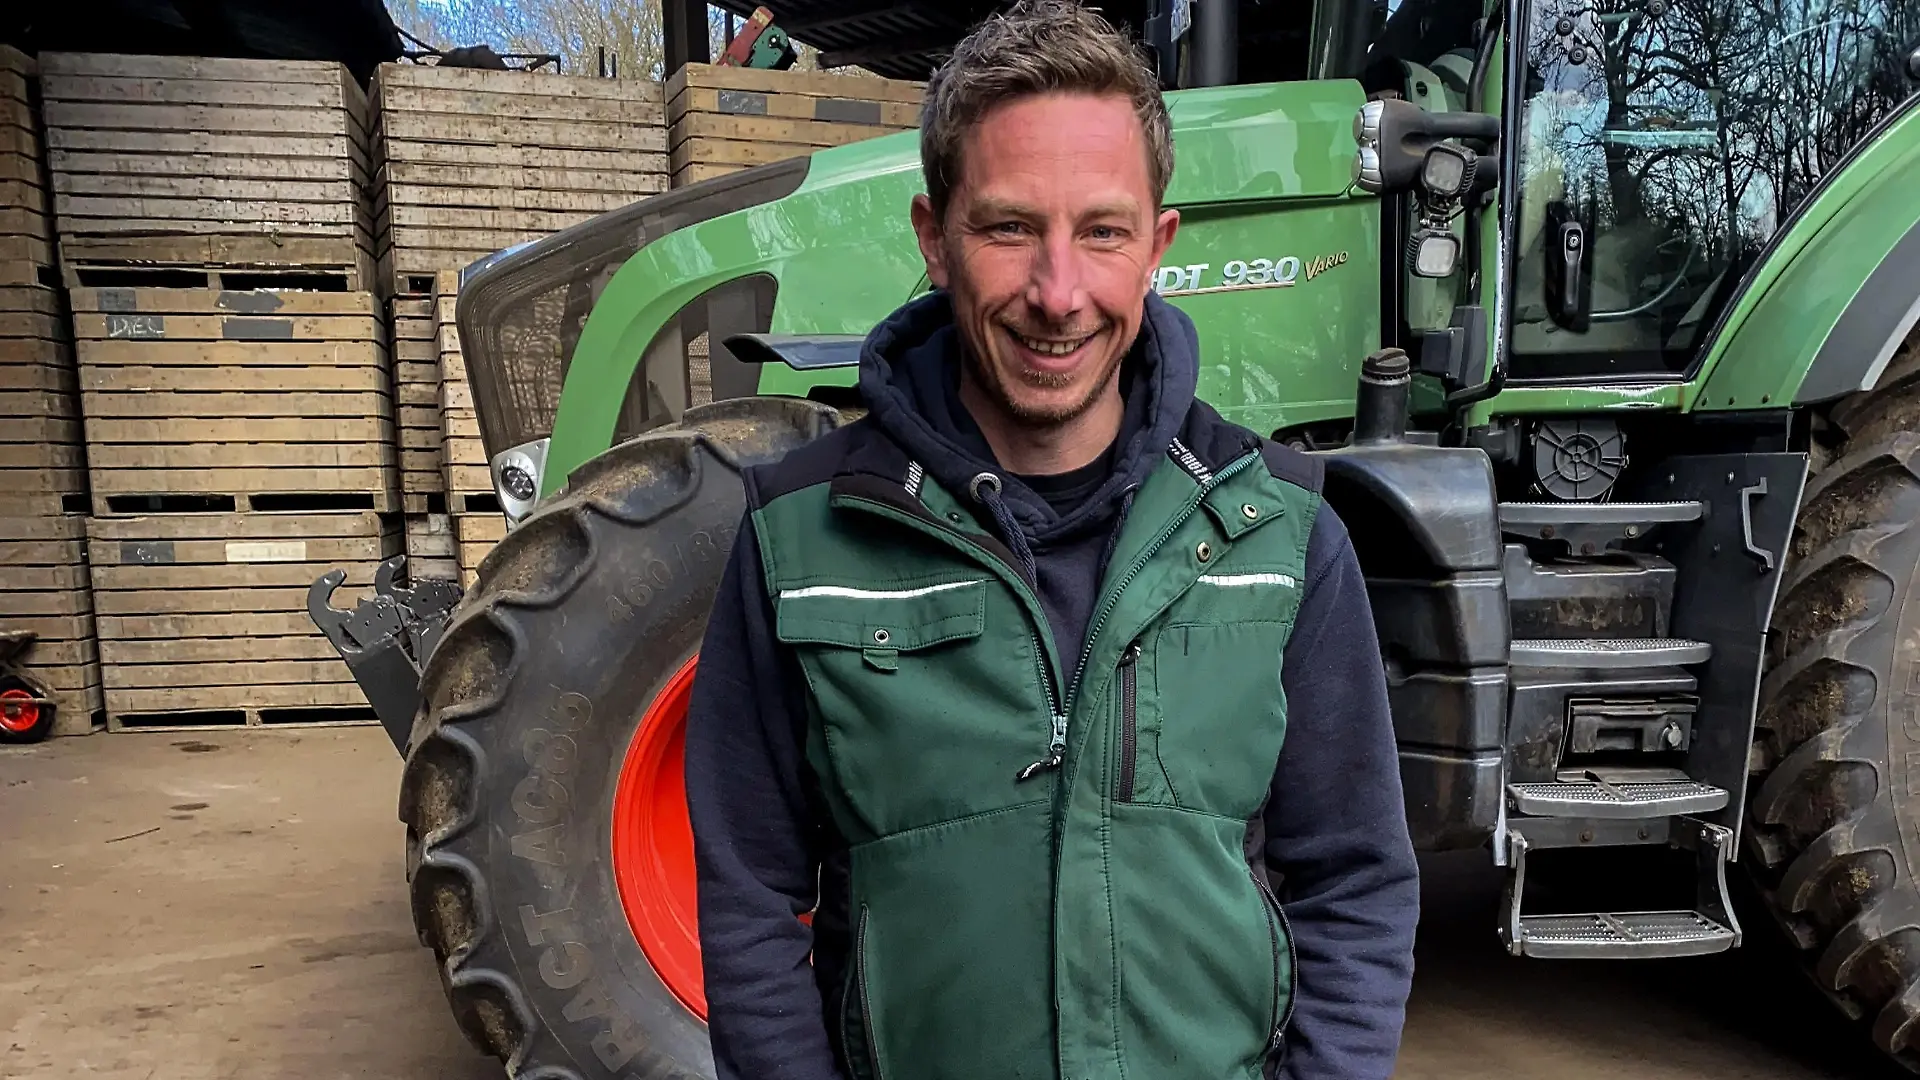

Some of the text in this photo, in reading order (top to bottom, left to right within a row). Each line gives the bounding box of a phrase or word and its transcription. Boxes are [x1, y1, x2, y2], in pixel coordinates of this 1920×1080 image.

[1152, 251, 1349, 293] DT 930 VARIO
